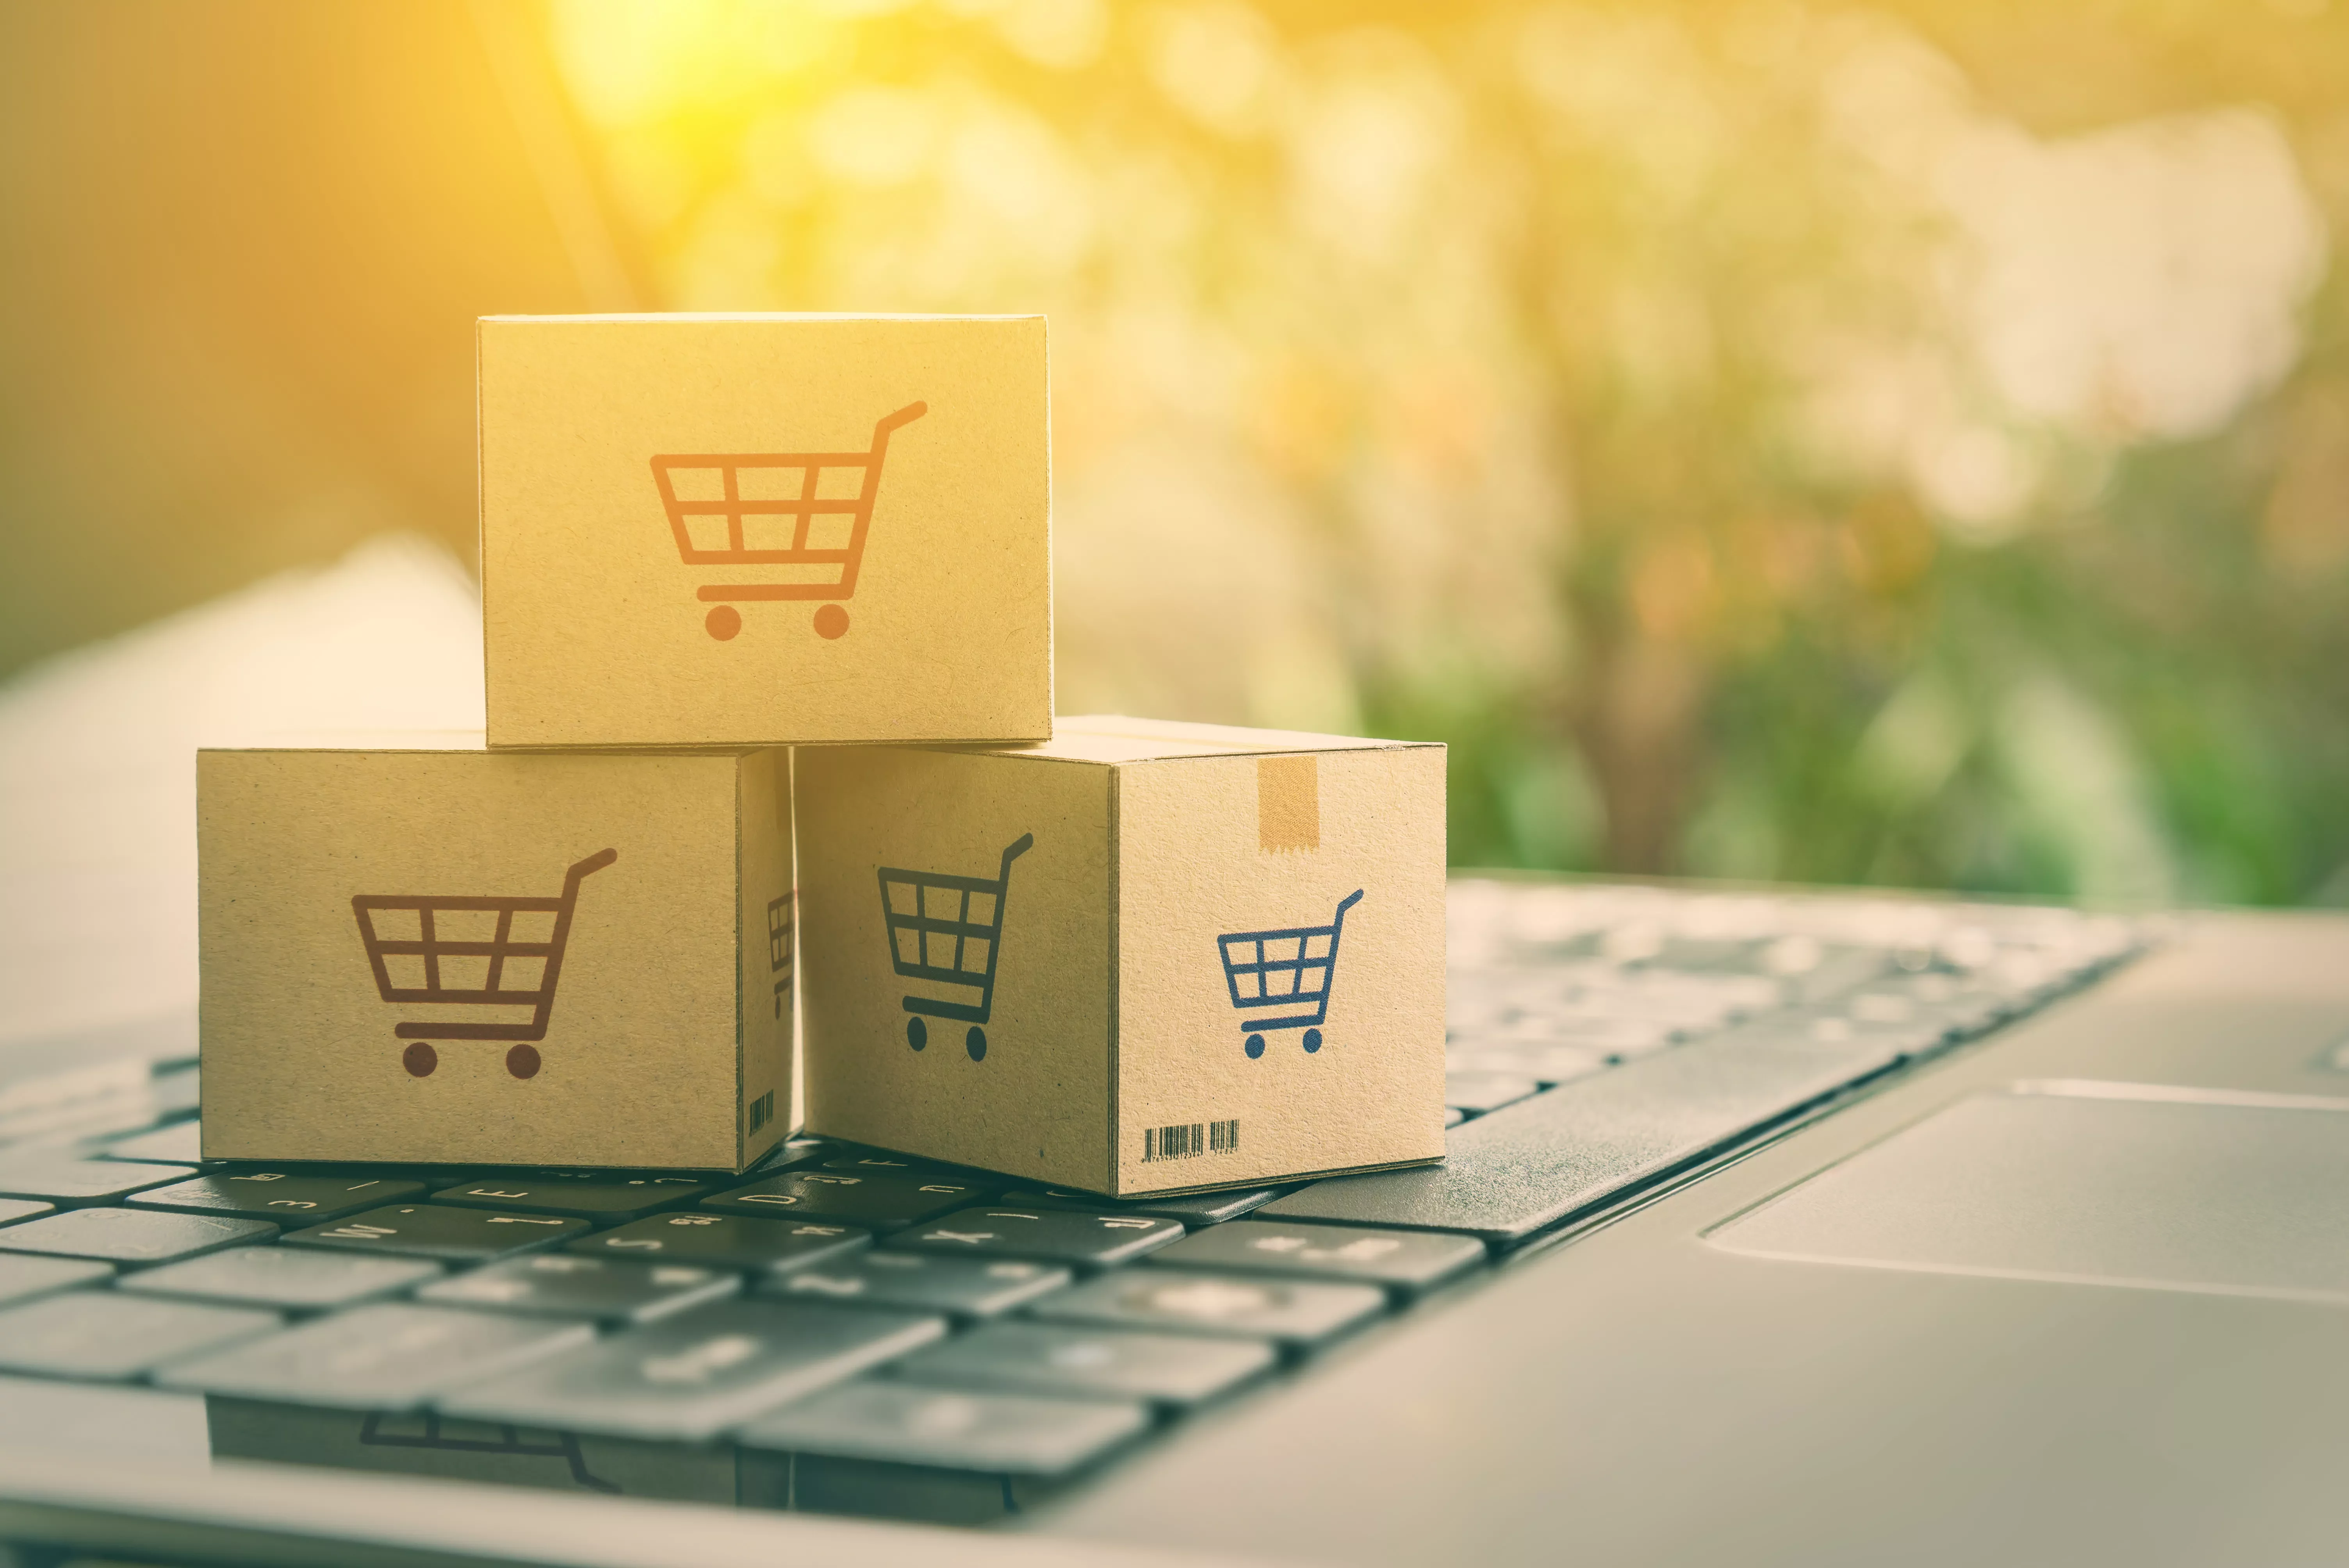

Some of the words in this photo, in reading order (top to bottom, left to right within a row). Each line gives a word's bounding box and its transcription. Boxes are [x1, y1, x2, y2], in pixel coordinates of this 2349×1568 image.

[467, 1188, 529, 1198] E
[267, 1200, 317, 1209] 3
[737, 1195, 797, 1205] D
[318, 1223, 397, 1239] W
[921, 1229, 994, 1244] X
[606, 1237, 663, 1250] S
